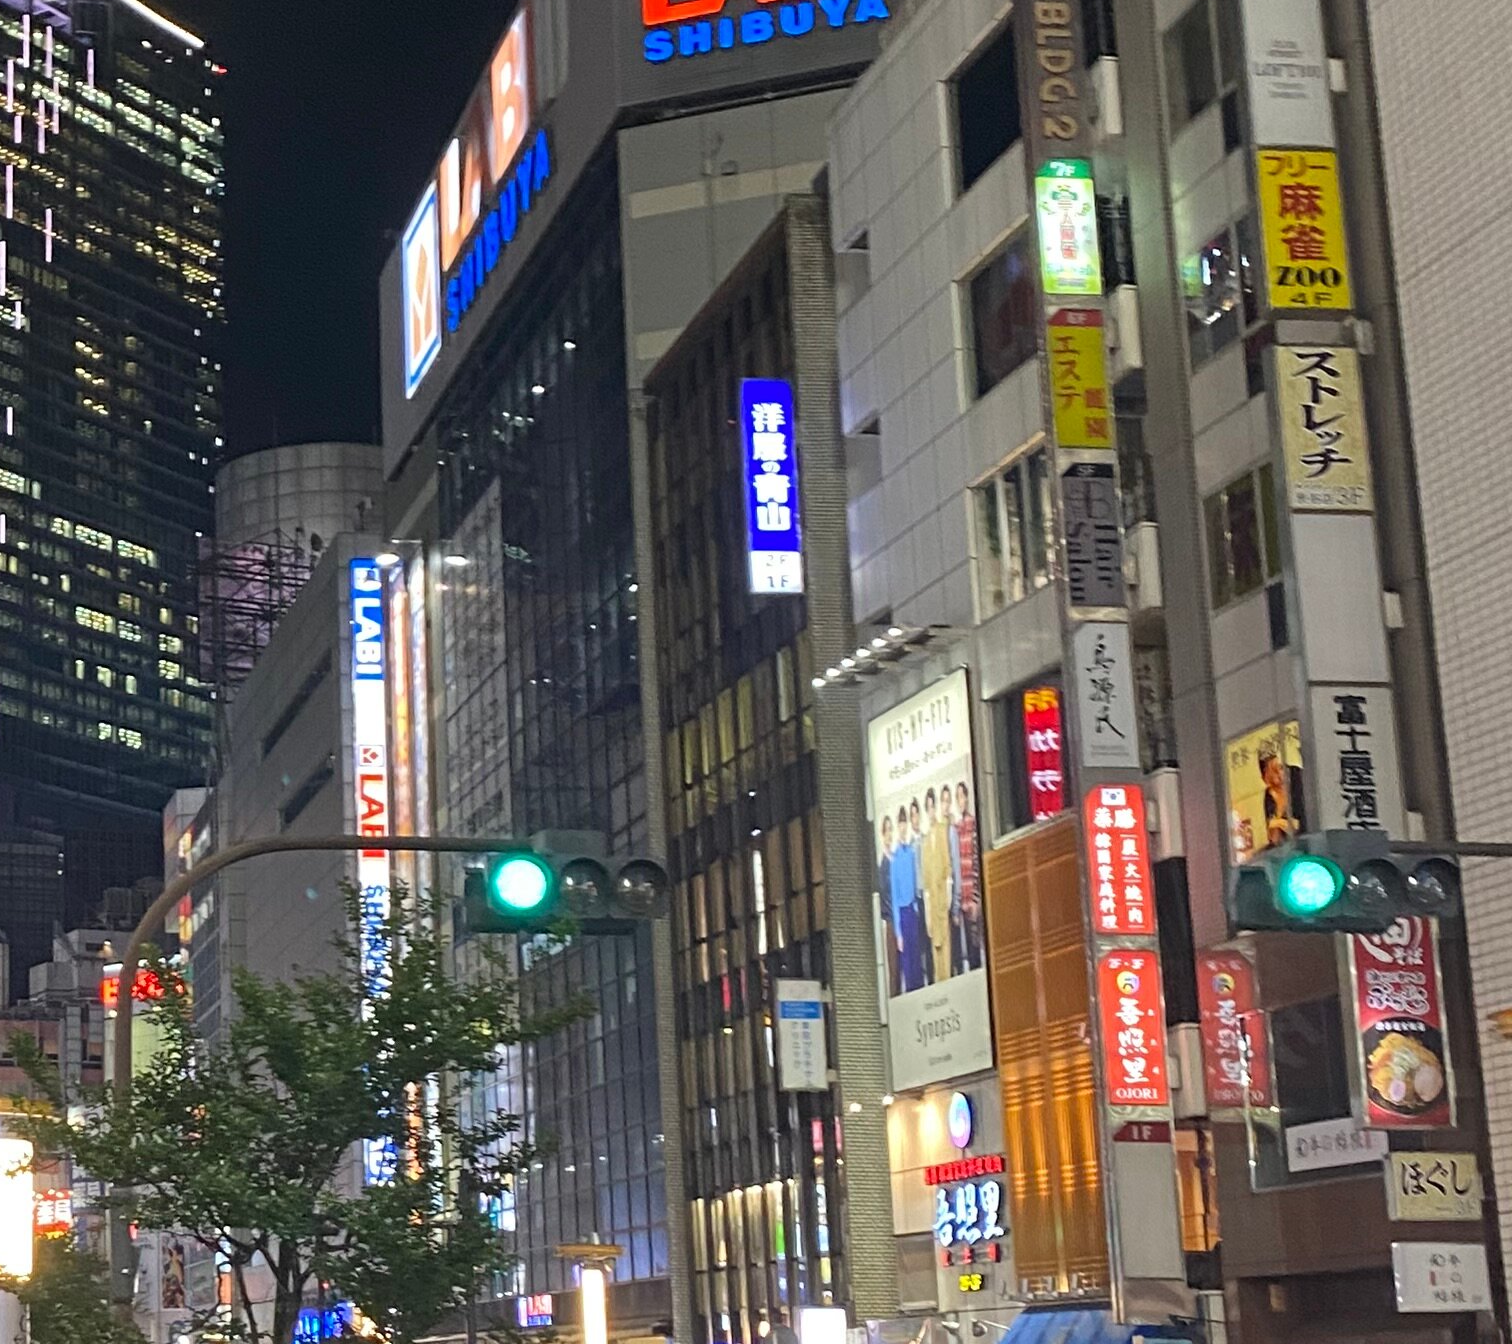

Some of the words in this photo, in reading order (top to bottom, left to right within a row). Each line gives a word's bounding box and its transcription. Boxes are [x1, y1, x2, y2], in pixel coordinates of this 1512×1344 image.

[1264, 155, 1331, 177] フリー
[1277, 182, 1330, 262] 麻雀
[1274, 265, 1342, 289] ZOO
[1289, 291, 1333, 307] 4F
[1053, 336, 1081, 407] エステ
[1291, 350, 1354, 480] ストレッチ
[751, 402, 791, 532] 洋服の青山
[355, 598, 382, 676] LABI
[1116, 1088, 1159, 1100] OJORI
[1401, 1159, 1474, 1195] ほぐし
